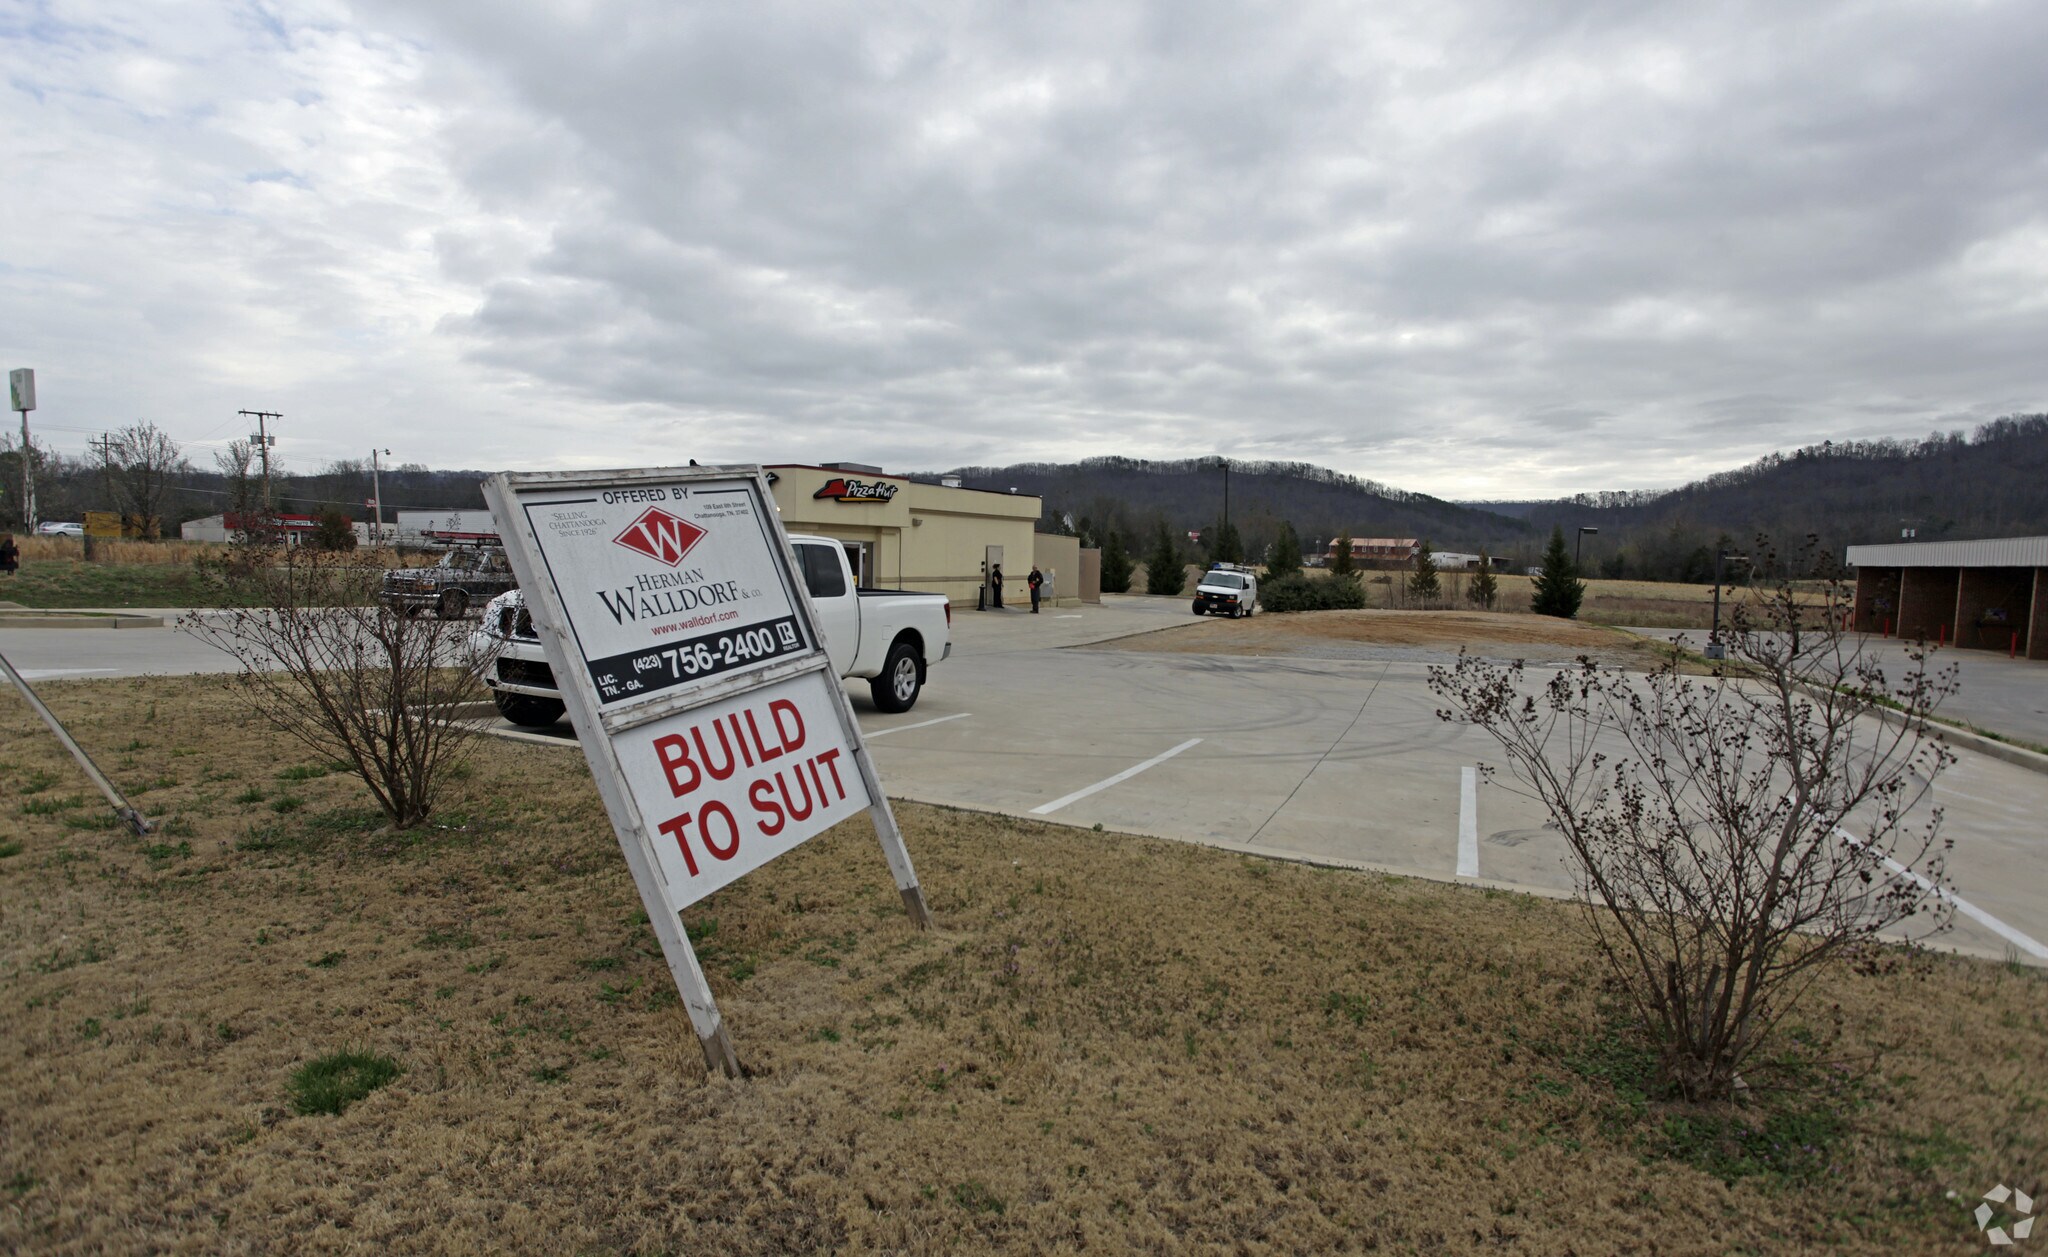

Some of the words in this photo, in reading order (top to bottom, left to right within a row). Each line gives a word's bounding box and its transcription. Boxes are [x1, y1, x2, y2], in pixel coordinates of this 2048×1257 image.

[602, 489, 667, 505] OFFERED
[671, 487, 689, 500] BY
[846, 481, 875, 498] Pizza
[875, 483, 897, 498] Hut
[549, 518, 607, 530] CHATTANOOGA
[635, 517, 684, 560] W
[635, 568, 705, 592] HERMAN
[596, 580, 739, 626] WALLDORF
[741, 588, 750, 599] &
[651, 609, 739, 636] www.walldorf.com
[632, 653, 662, 674] (423)
[662, 628, 776, 679] 756-2400
[597, 674, 618, 686] LIC.
[602, 685, 621, 697] TN.
[626, 680, 644, 691] GA.
[652, 699, 806, 799] BUILD
[657, 800, 740, 878] TO
[748, 747, 846, 837] SUIT
